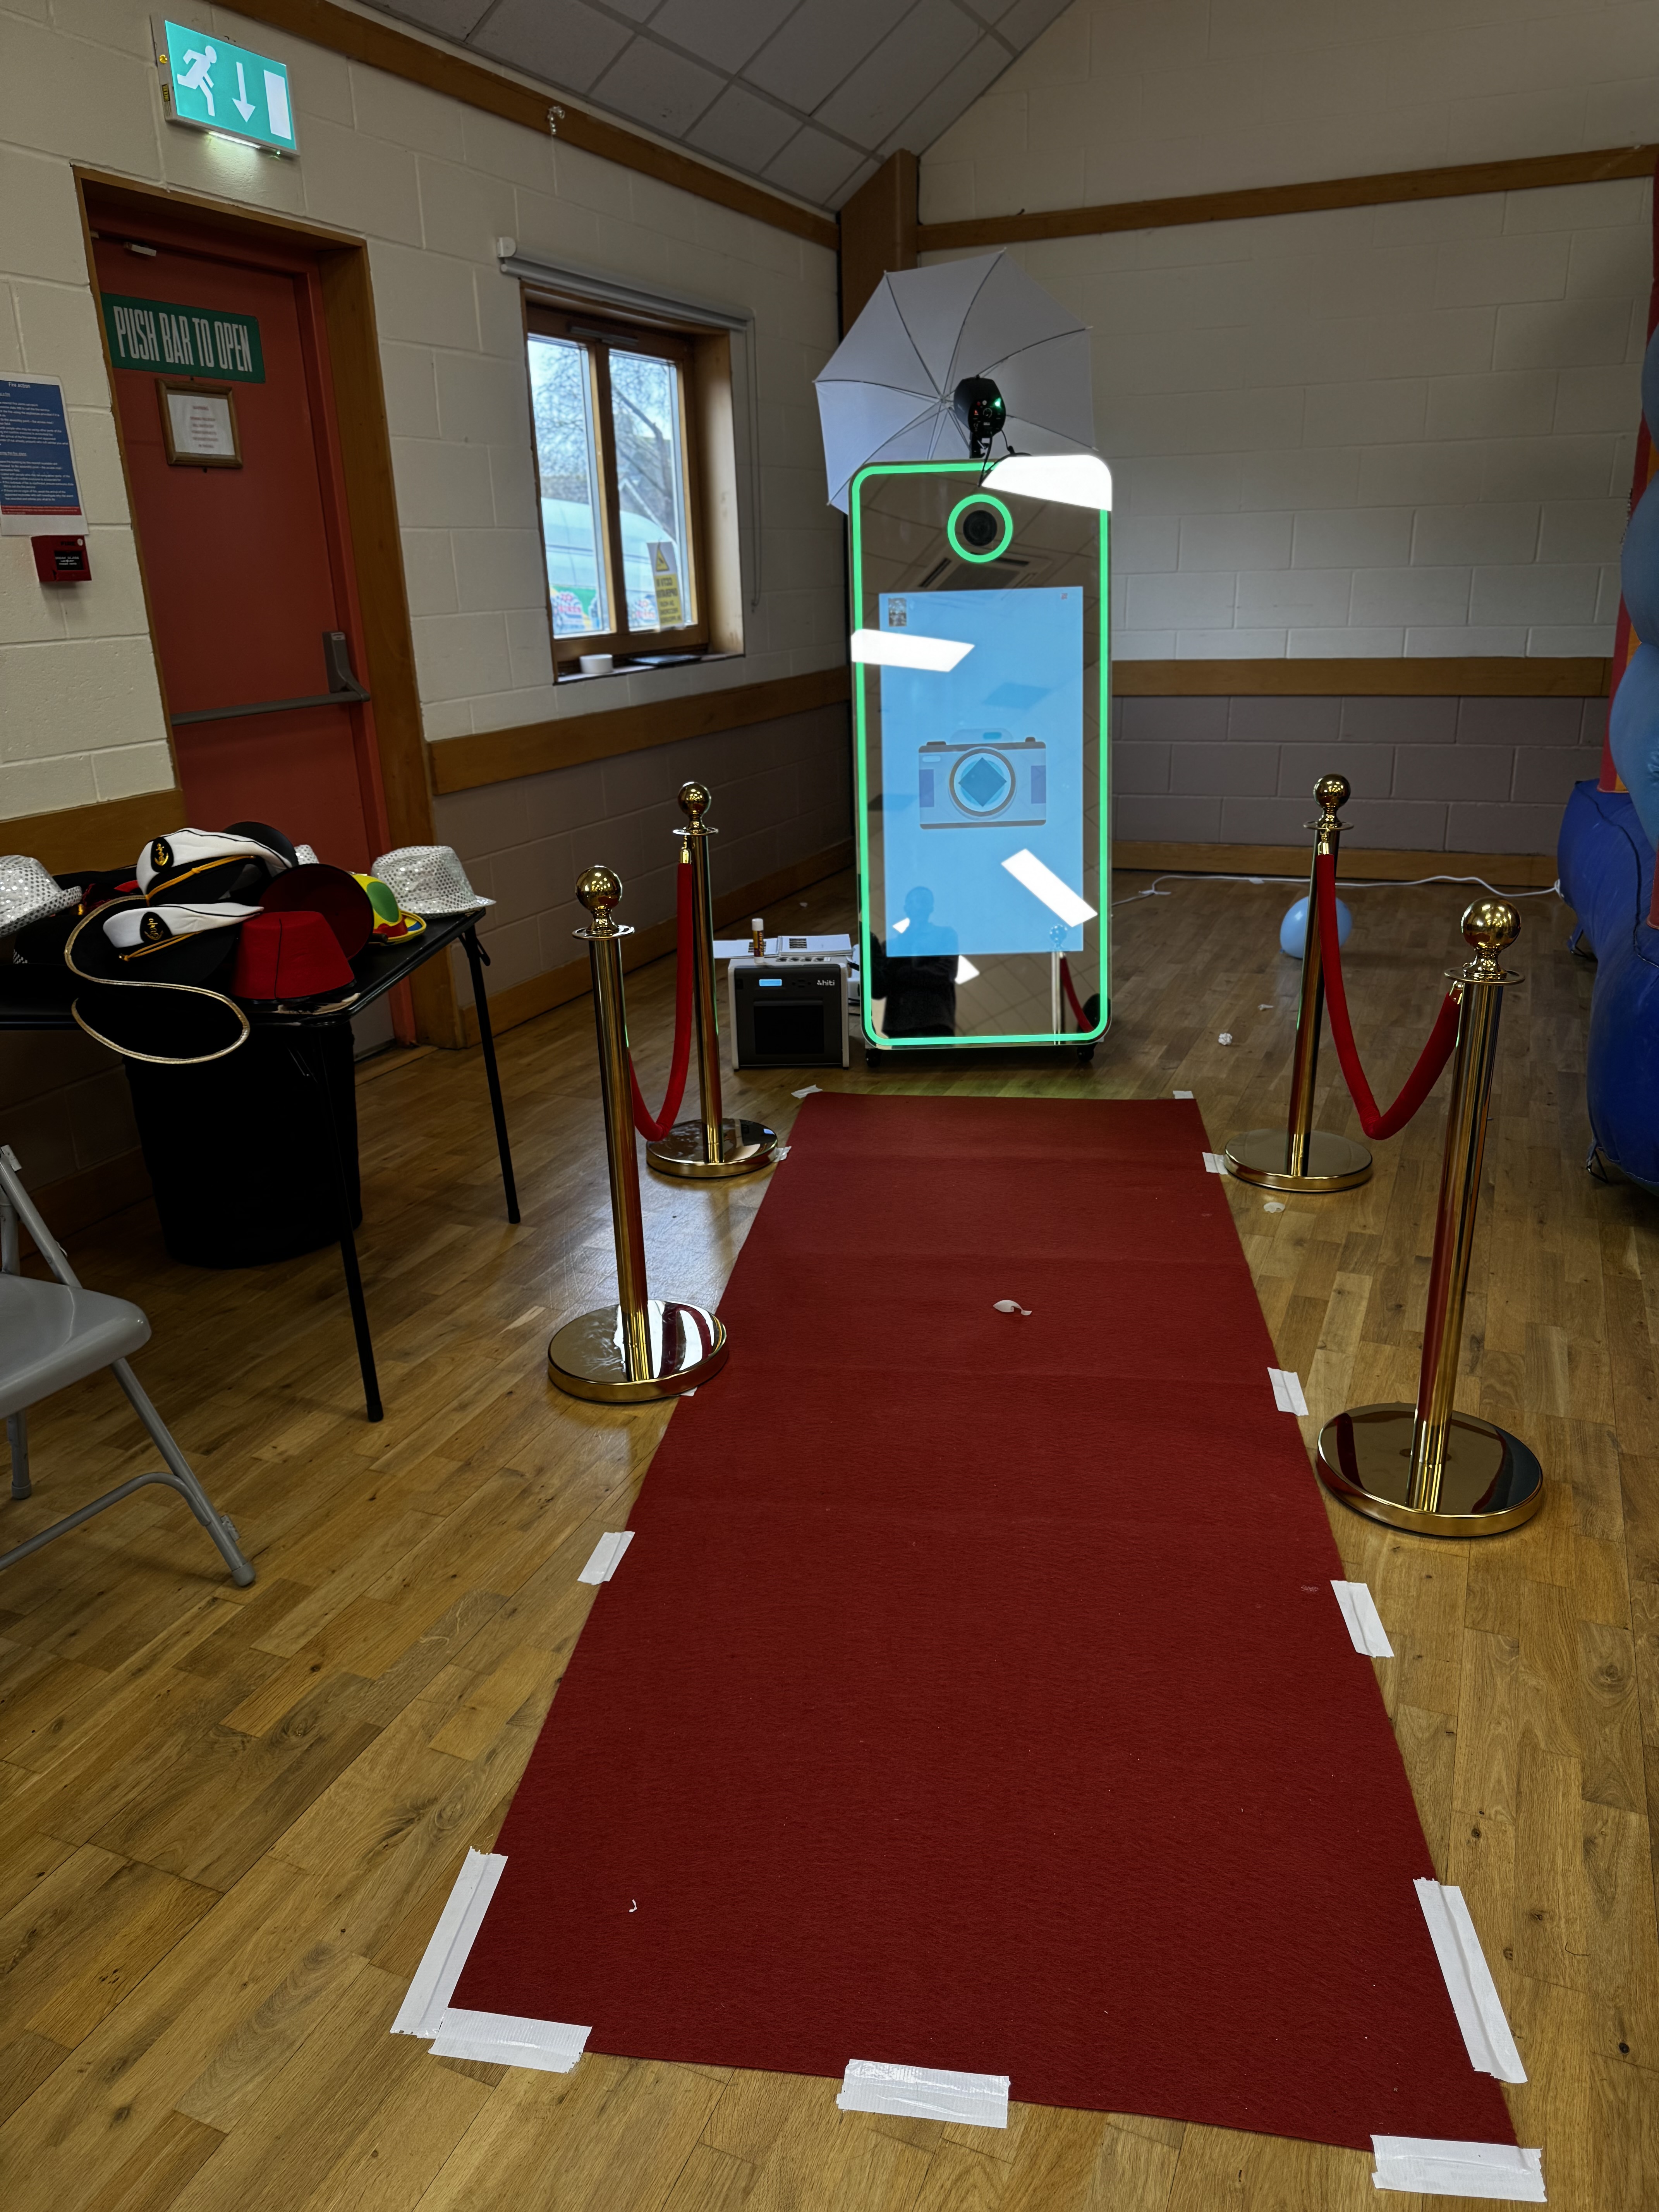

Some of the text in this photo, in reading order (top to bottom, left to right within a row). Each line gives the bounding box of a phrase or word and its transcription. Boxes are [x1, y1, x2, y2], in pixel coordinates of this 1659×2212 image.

[113, 306, 253, 372] PUSH BAR TO OPEN
